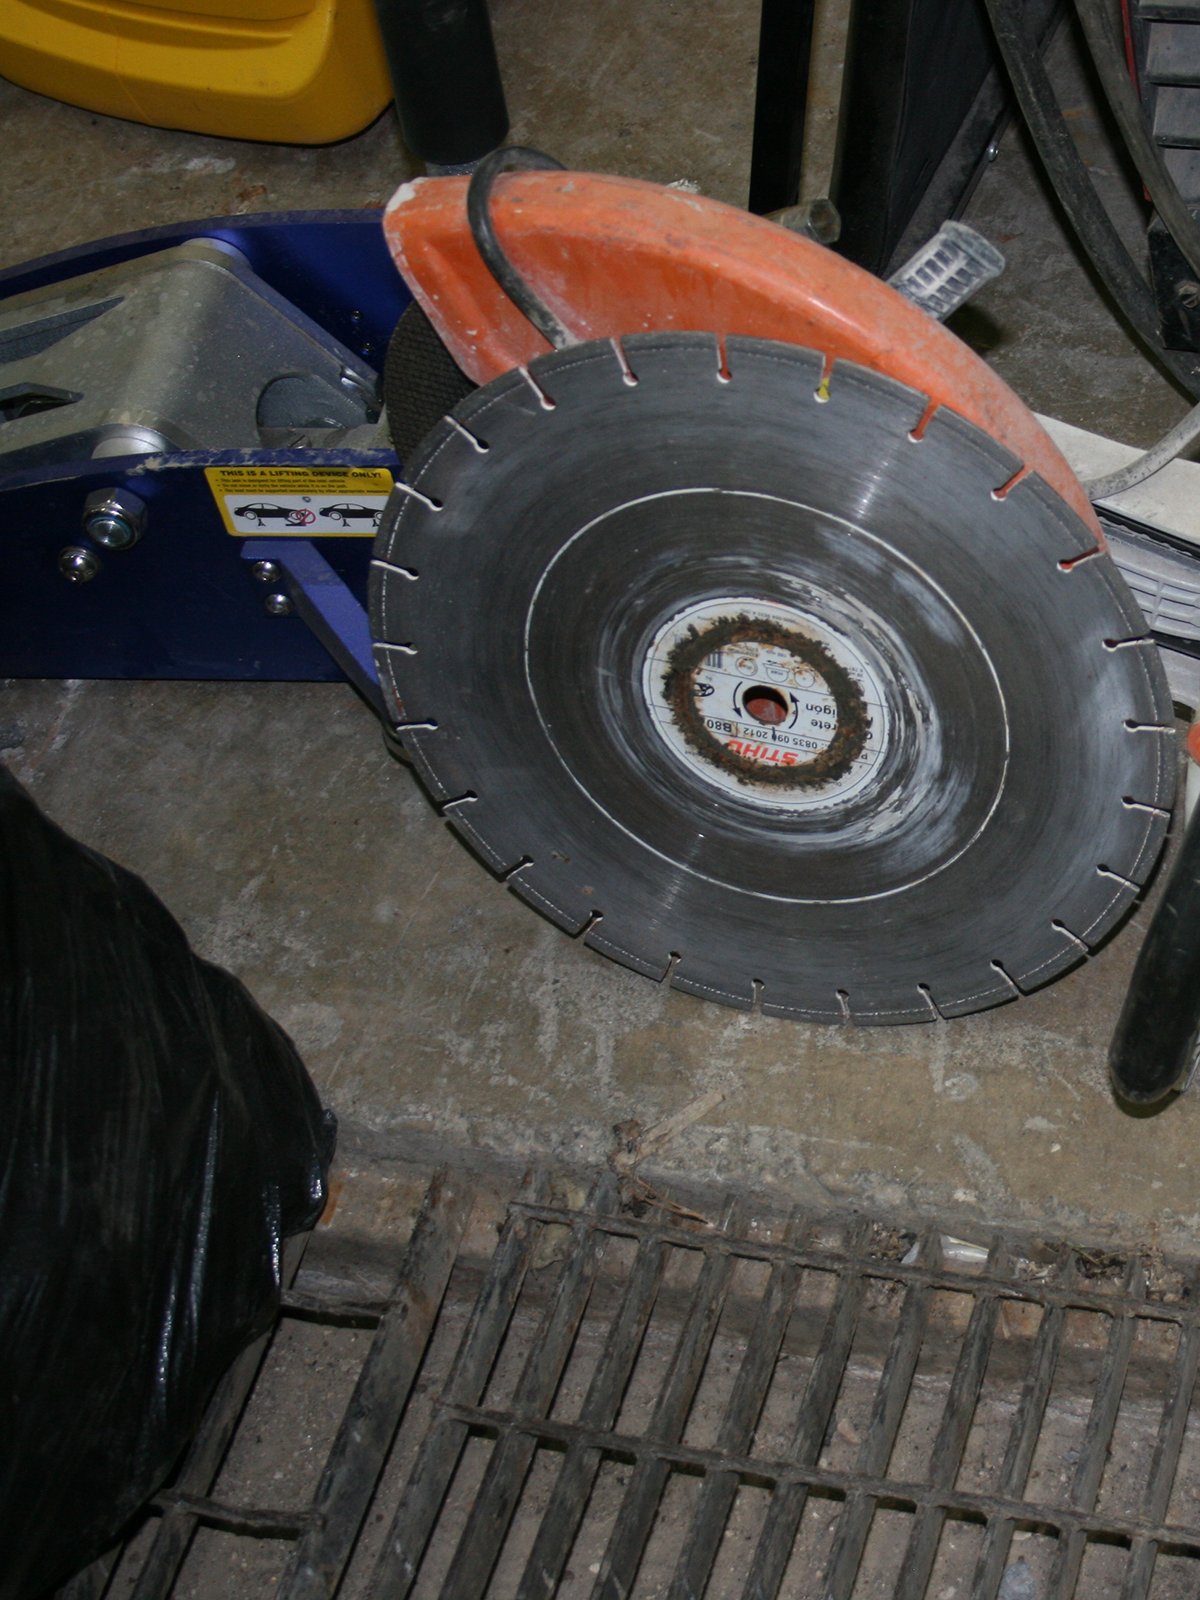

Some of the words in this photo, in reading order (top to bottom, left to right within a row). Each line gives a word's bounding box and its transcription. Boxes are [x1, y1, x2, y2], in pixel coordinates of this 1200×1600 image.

[311, 470, 348, 478] DEVICE
[351, 471, 382, 479] ONLY!
[706, 719, 733, 733] B80
[743, 727, 768, 739] 2012
[792, 737, 818, 750] 0835
